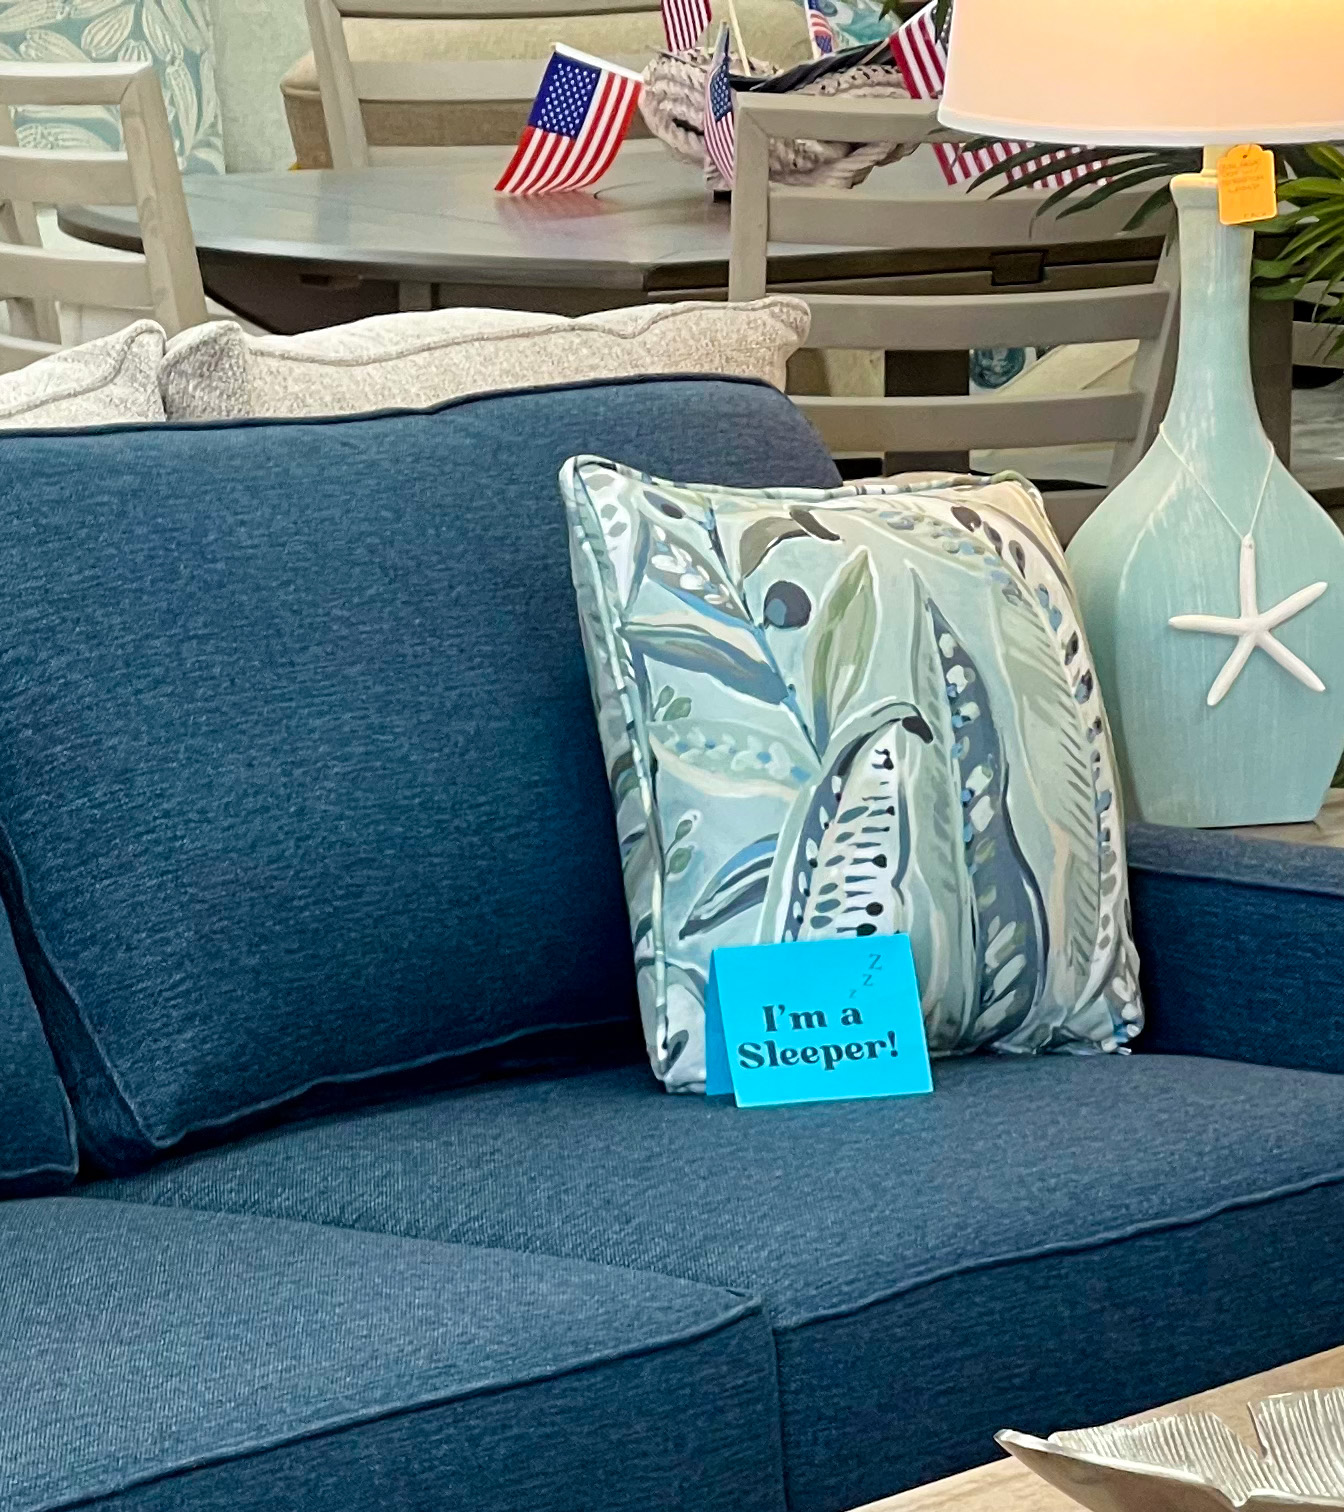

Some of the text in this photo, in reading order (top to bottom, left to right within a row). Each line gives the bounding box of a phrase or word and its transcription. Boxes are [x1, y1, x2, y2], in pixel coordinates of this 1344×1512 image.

[762, 1004, 864, 1033] I'm a
[737, 1030, 899, 1071] Sleeper!
